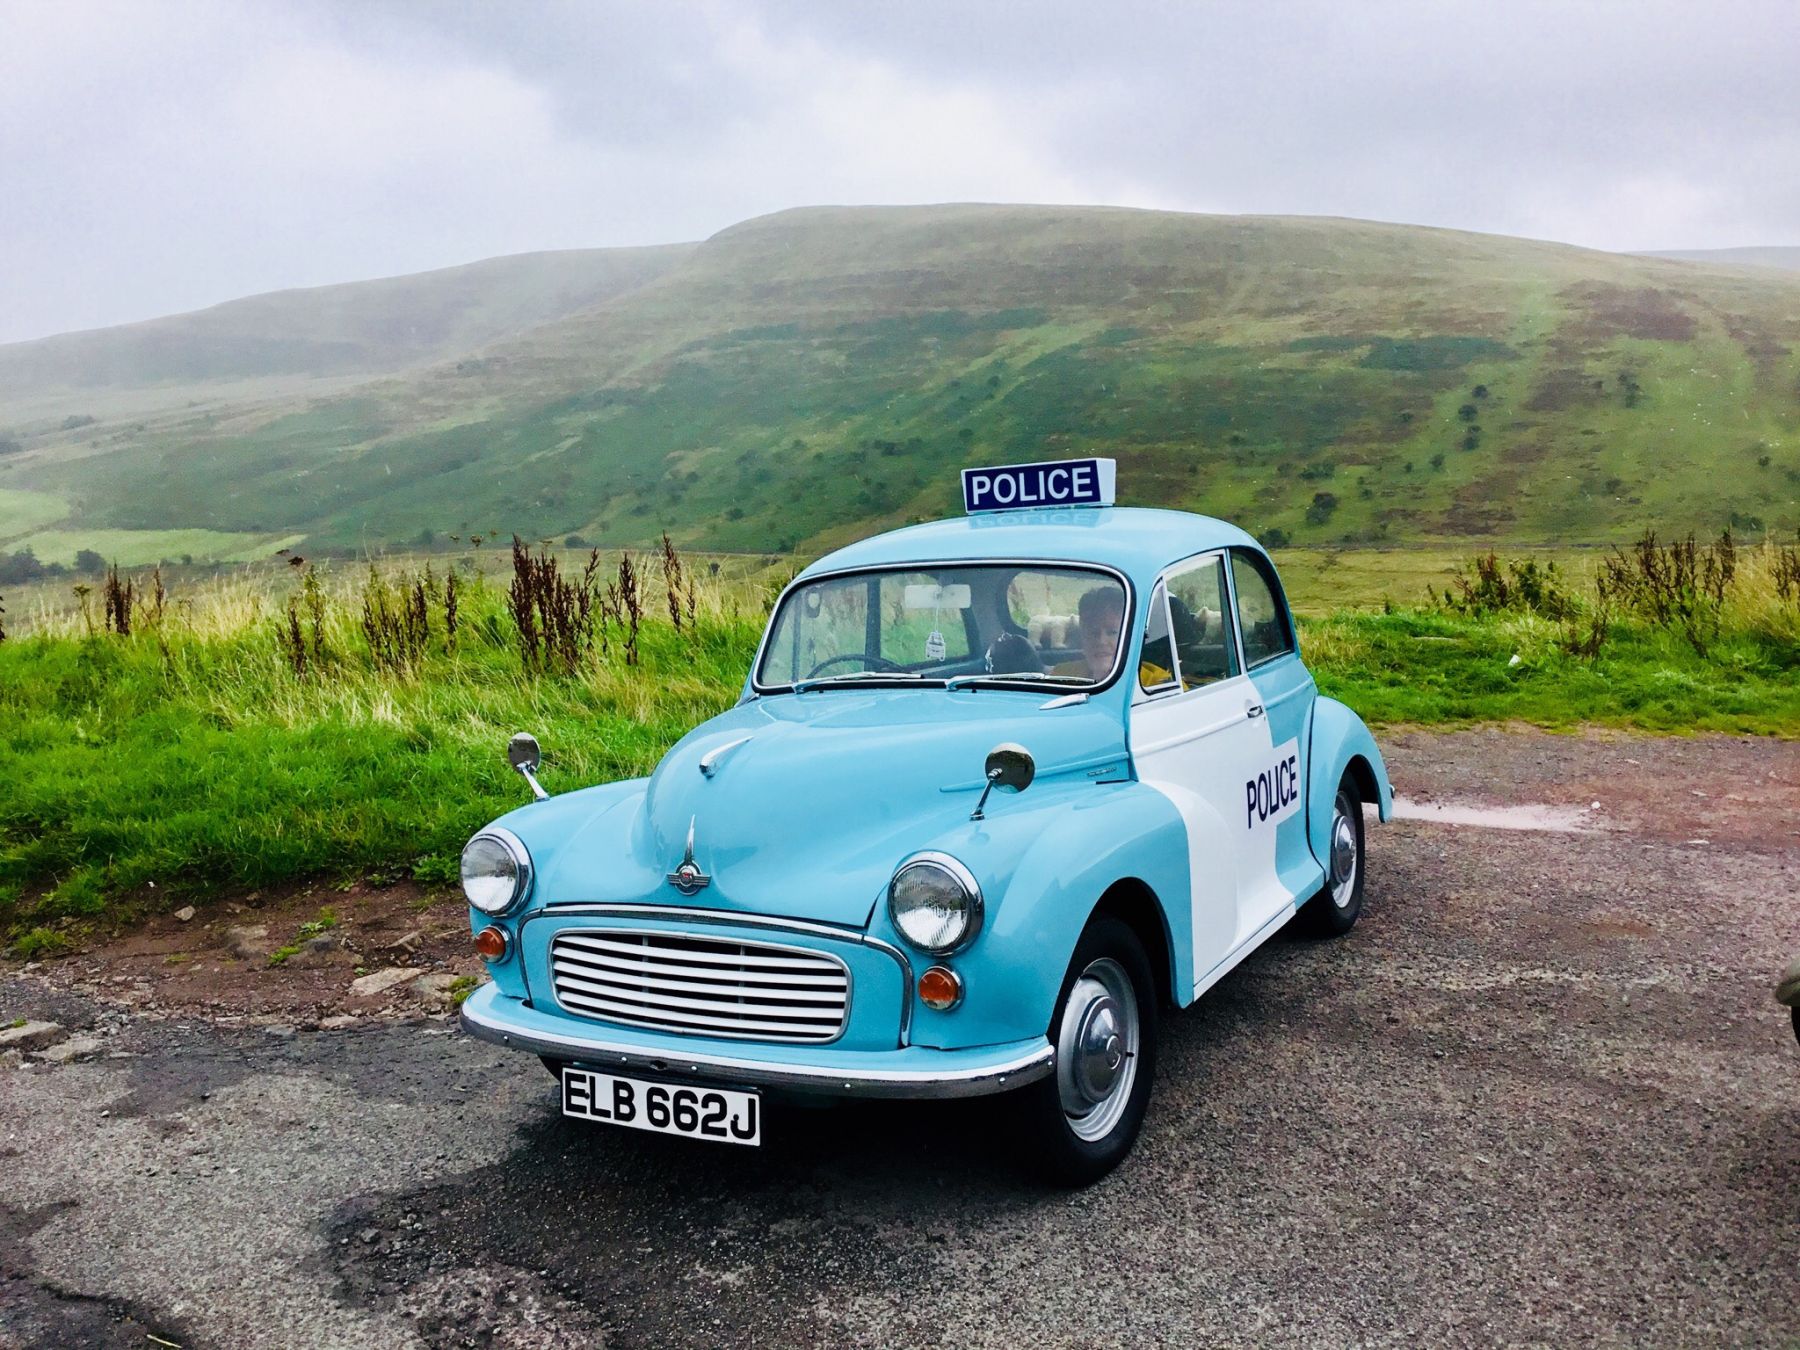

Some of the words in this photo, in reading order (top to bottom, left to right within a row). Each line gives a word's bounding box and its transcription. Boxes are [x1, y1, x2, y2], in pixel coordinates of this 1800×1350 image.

[972, 466, 1093, 505] POLICE
[1246, 755, 1297, 829] POLICE
[564, 1071, 636, 1122] ELB
[646, 1086, 756, 1140] 662J
